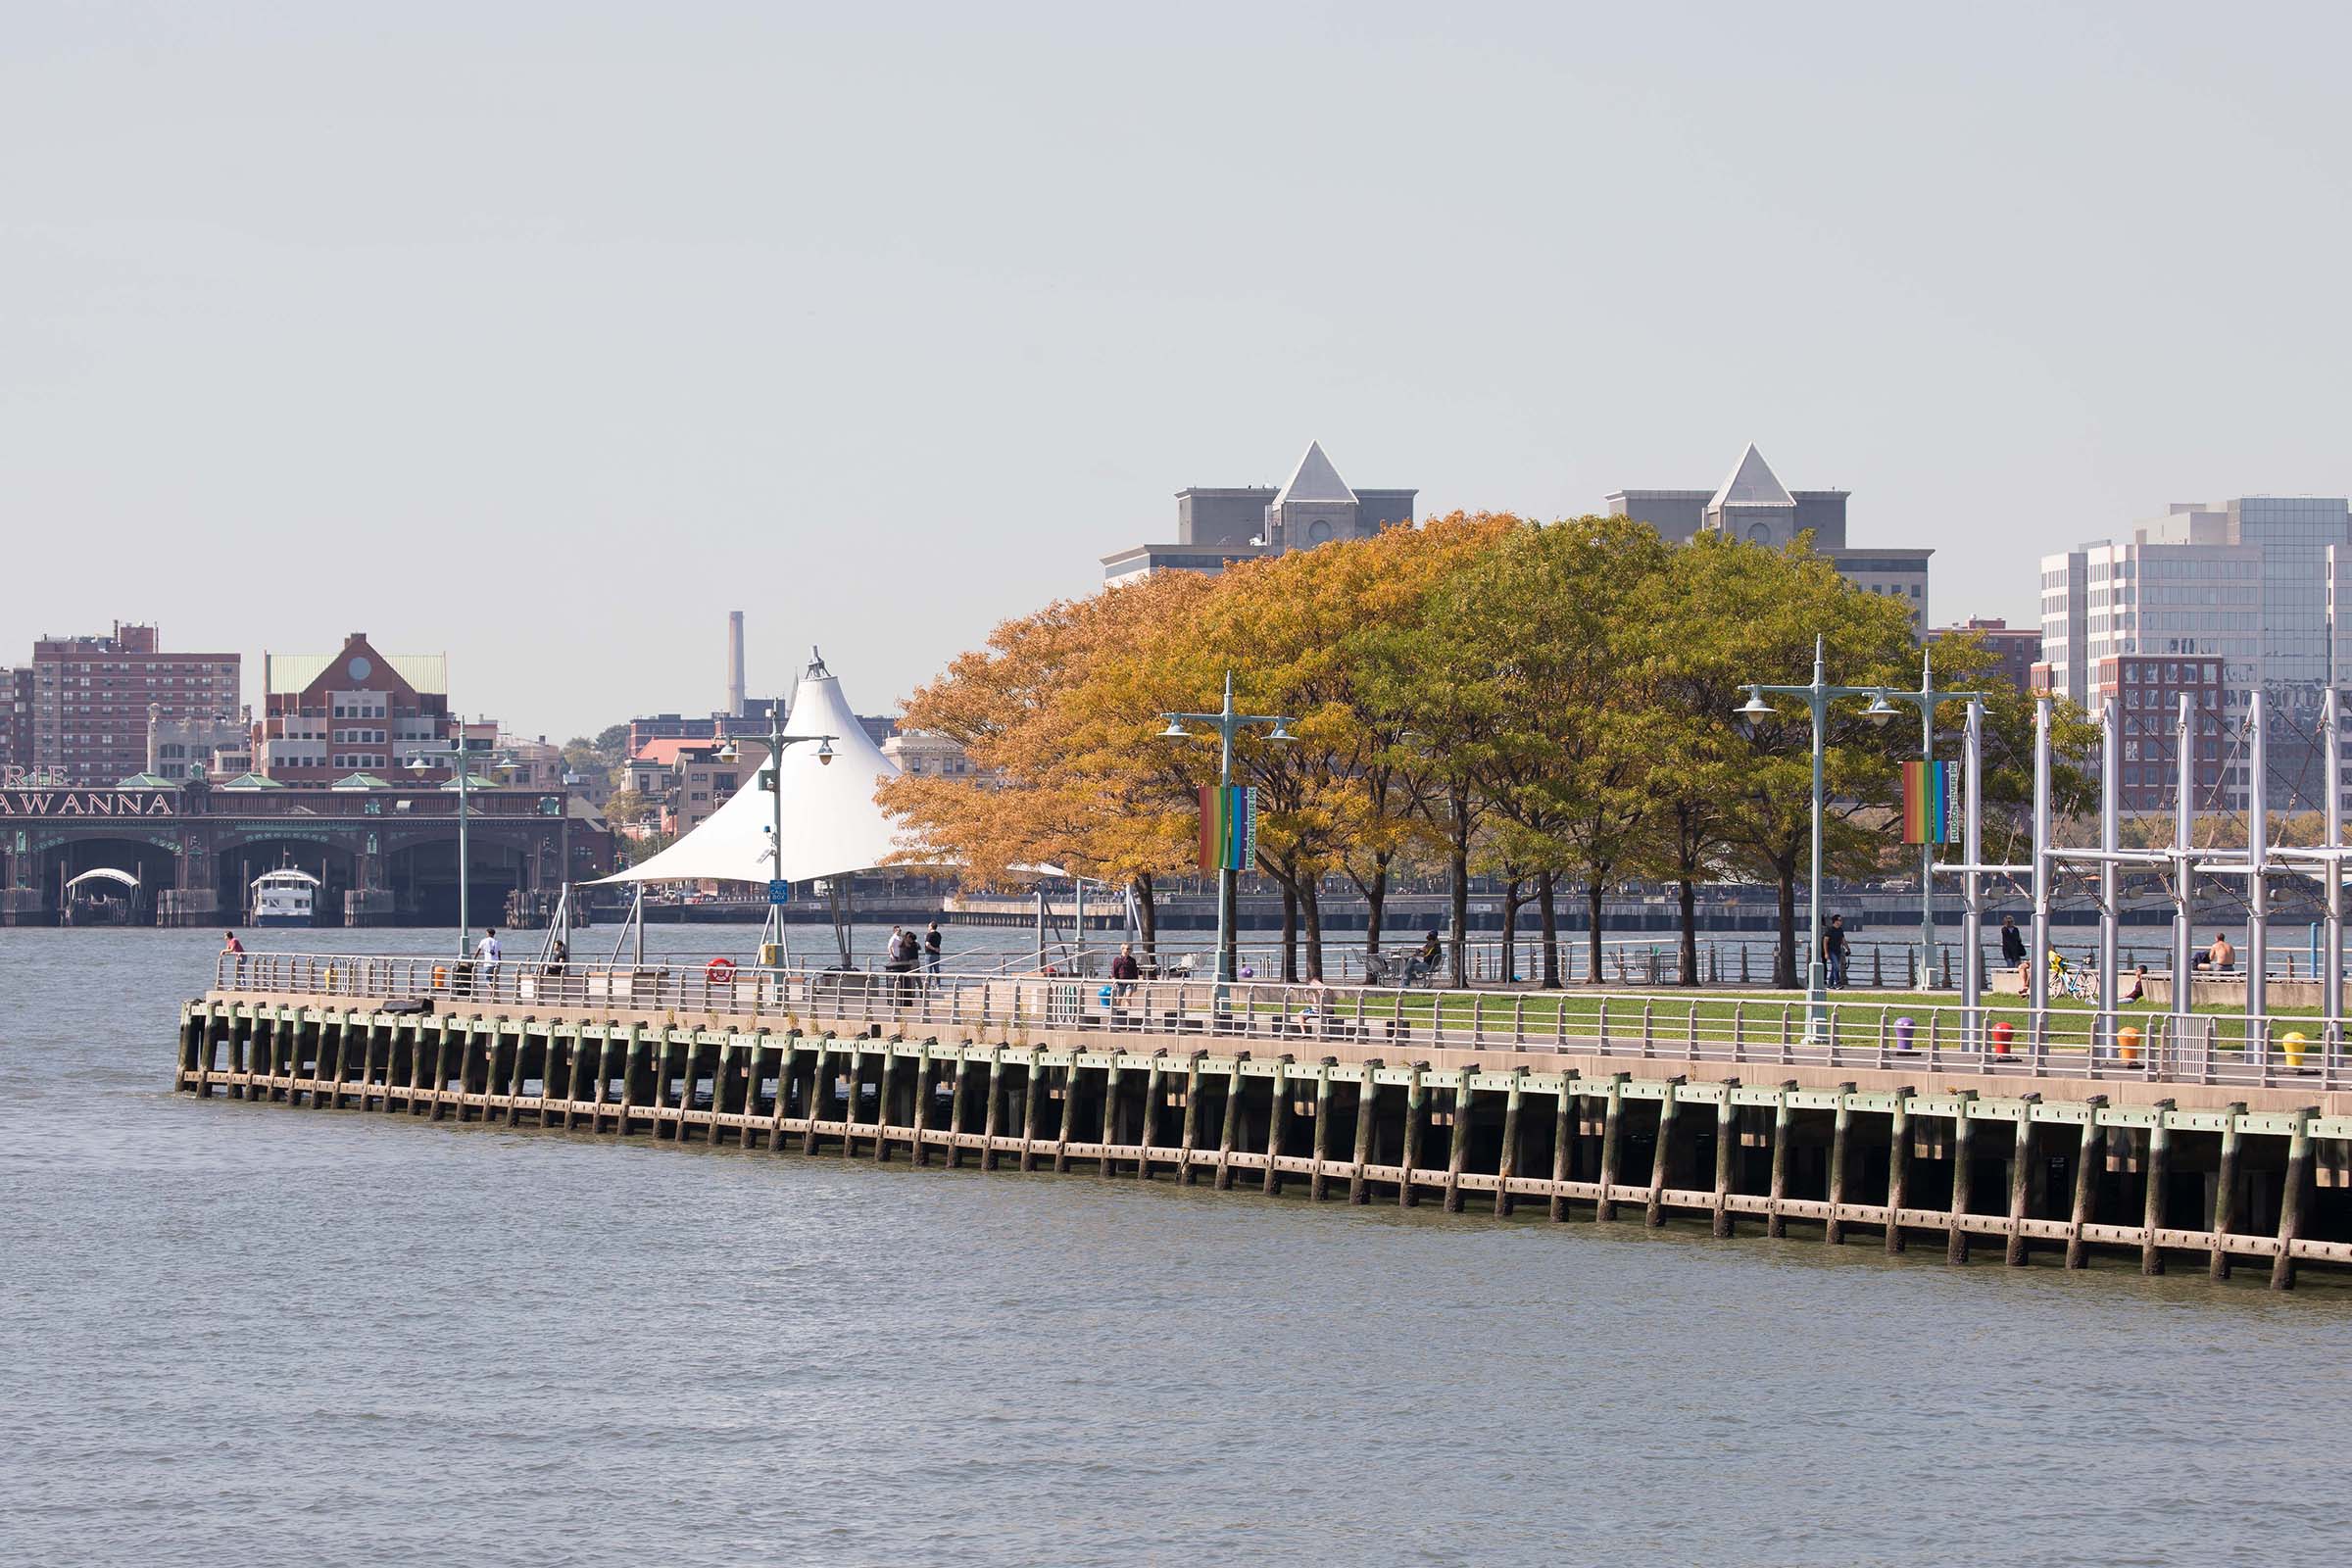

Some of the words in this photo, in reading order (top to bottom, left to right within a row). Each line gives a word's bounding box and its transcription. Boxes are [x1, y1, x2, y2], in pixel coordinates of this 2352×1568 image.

[1950, 762, 1957, 774] PK
[4, 765, 69, 785] RIE
[1248, 788, 1255, 801] PK
